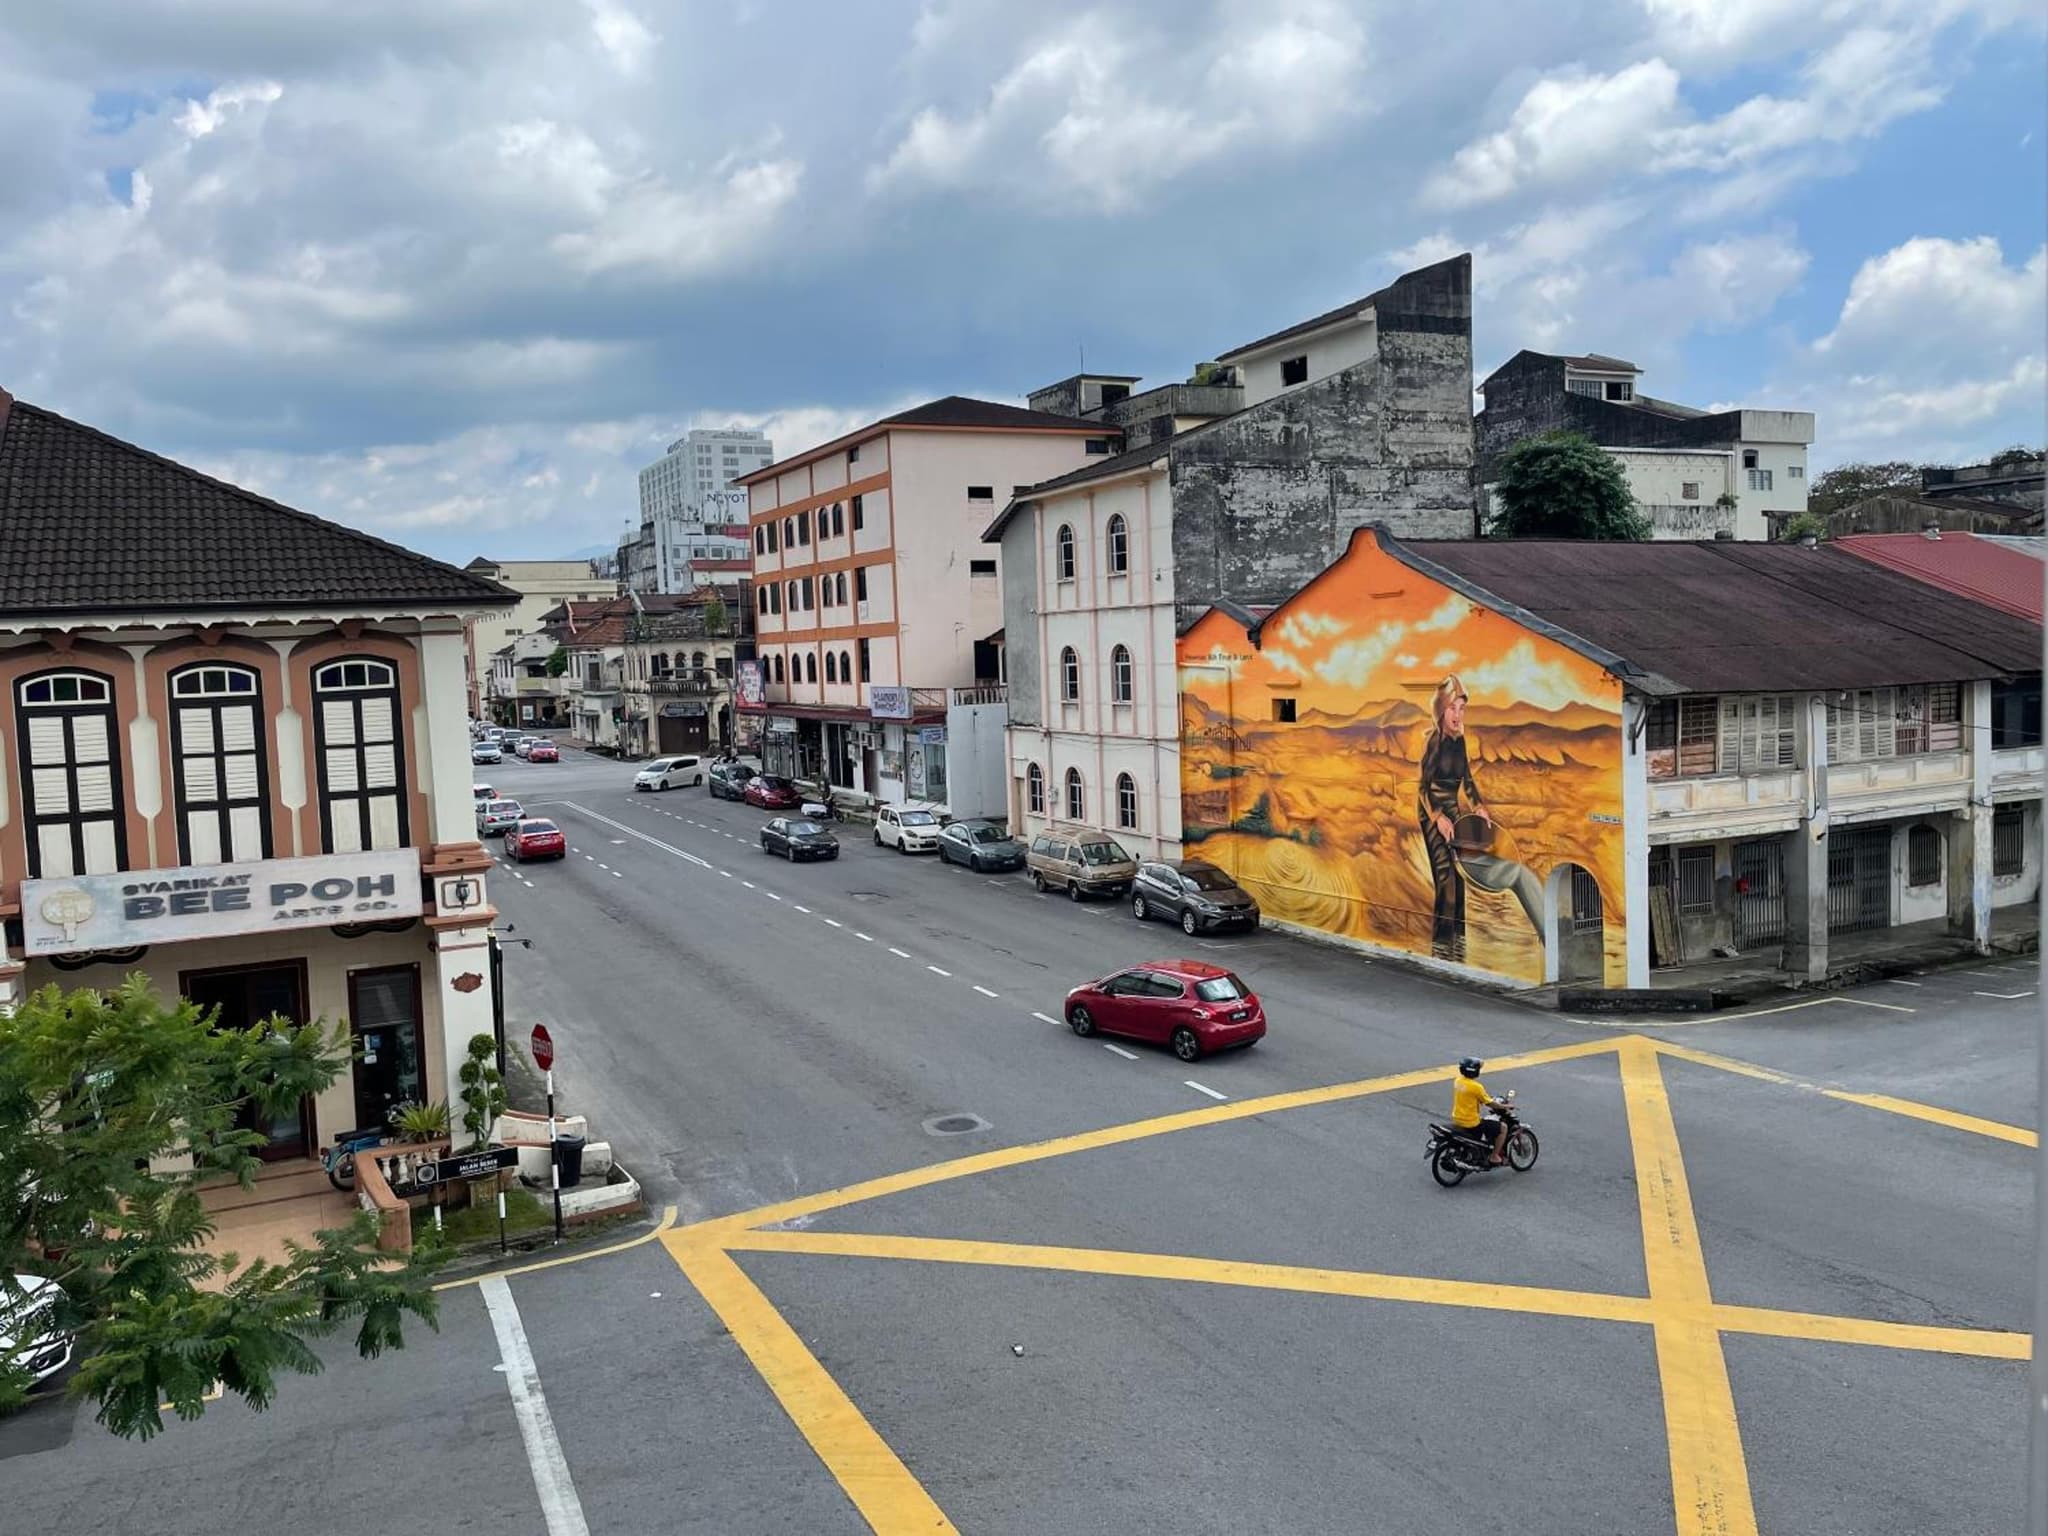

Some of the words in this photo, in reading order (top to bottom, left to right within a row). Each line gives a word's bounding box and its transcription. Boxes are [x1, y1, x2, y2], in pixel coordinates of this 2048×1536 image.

[122, 873, 252, 896] SYARIKAT
[124, 887, 251, 921] BEE
[270, 874, 395, 906] POH
[273, 905, 344, 920] ARTS
[354, 901, 398, 912] CO.
